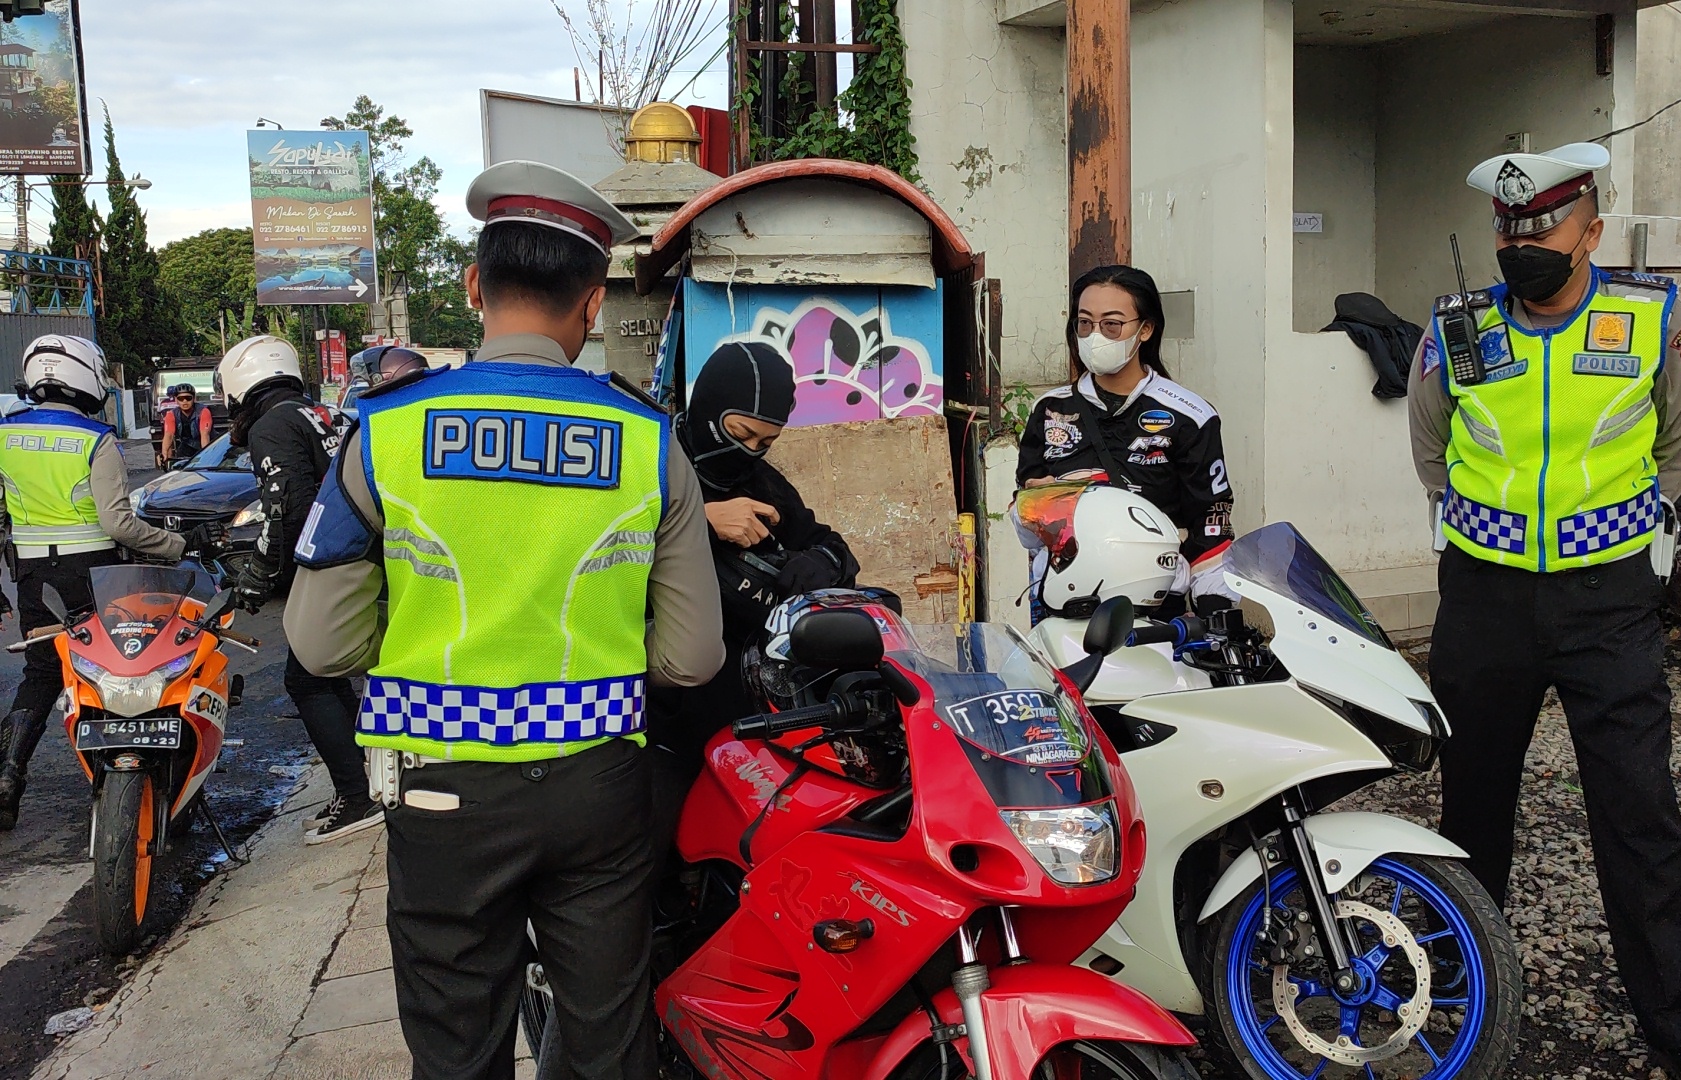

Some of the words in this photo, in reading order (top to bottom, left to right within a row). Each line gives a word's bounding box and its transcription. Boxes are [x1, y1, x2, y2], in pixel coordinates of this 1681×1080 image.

[266, 206, 305, 219] Makan
[274, 225, 310, 233] 2786461
[331, 225, 367, 233] 2786915
[620, 319, 663, 336] SELAM
[1577, 356, 1636, 374] POLISI
[1157, 387, 1178, 399] DAILY
[6, 434, 85, 454] POLISI
[431, 415, 615, 480] POLISI
[1209, 458, 1229, 496] 2
[81, 724, 91, 737] D
[157, 720, 178, 733] ME
[955, 707, 975, 733] T
[850, 880, 917, 927] KIPS
